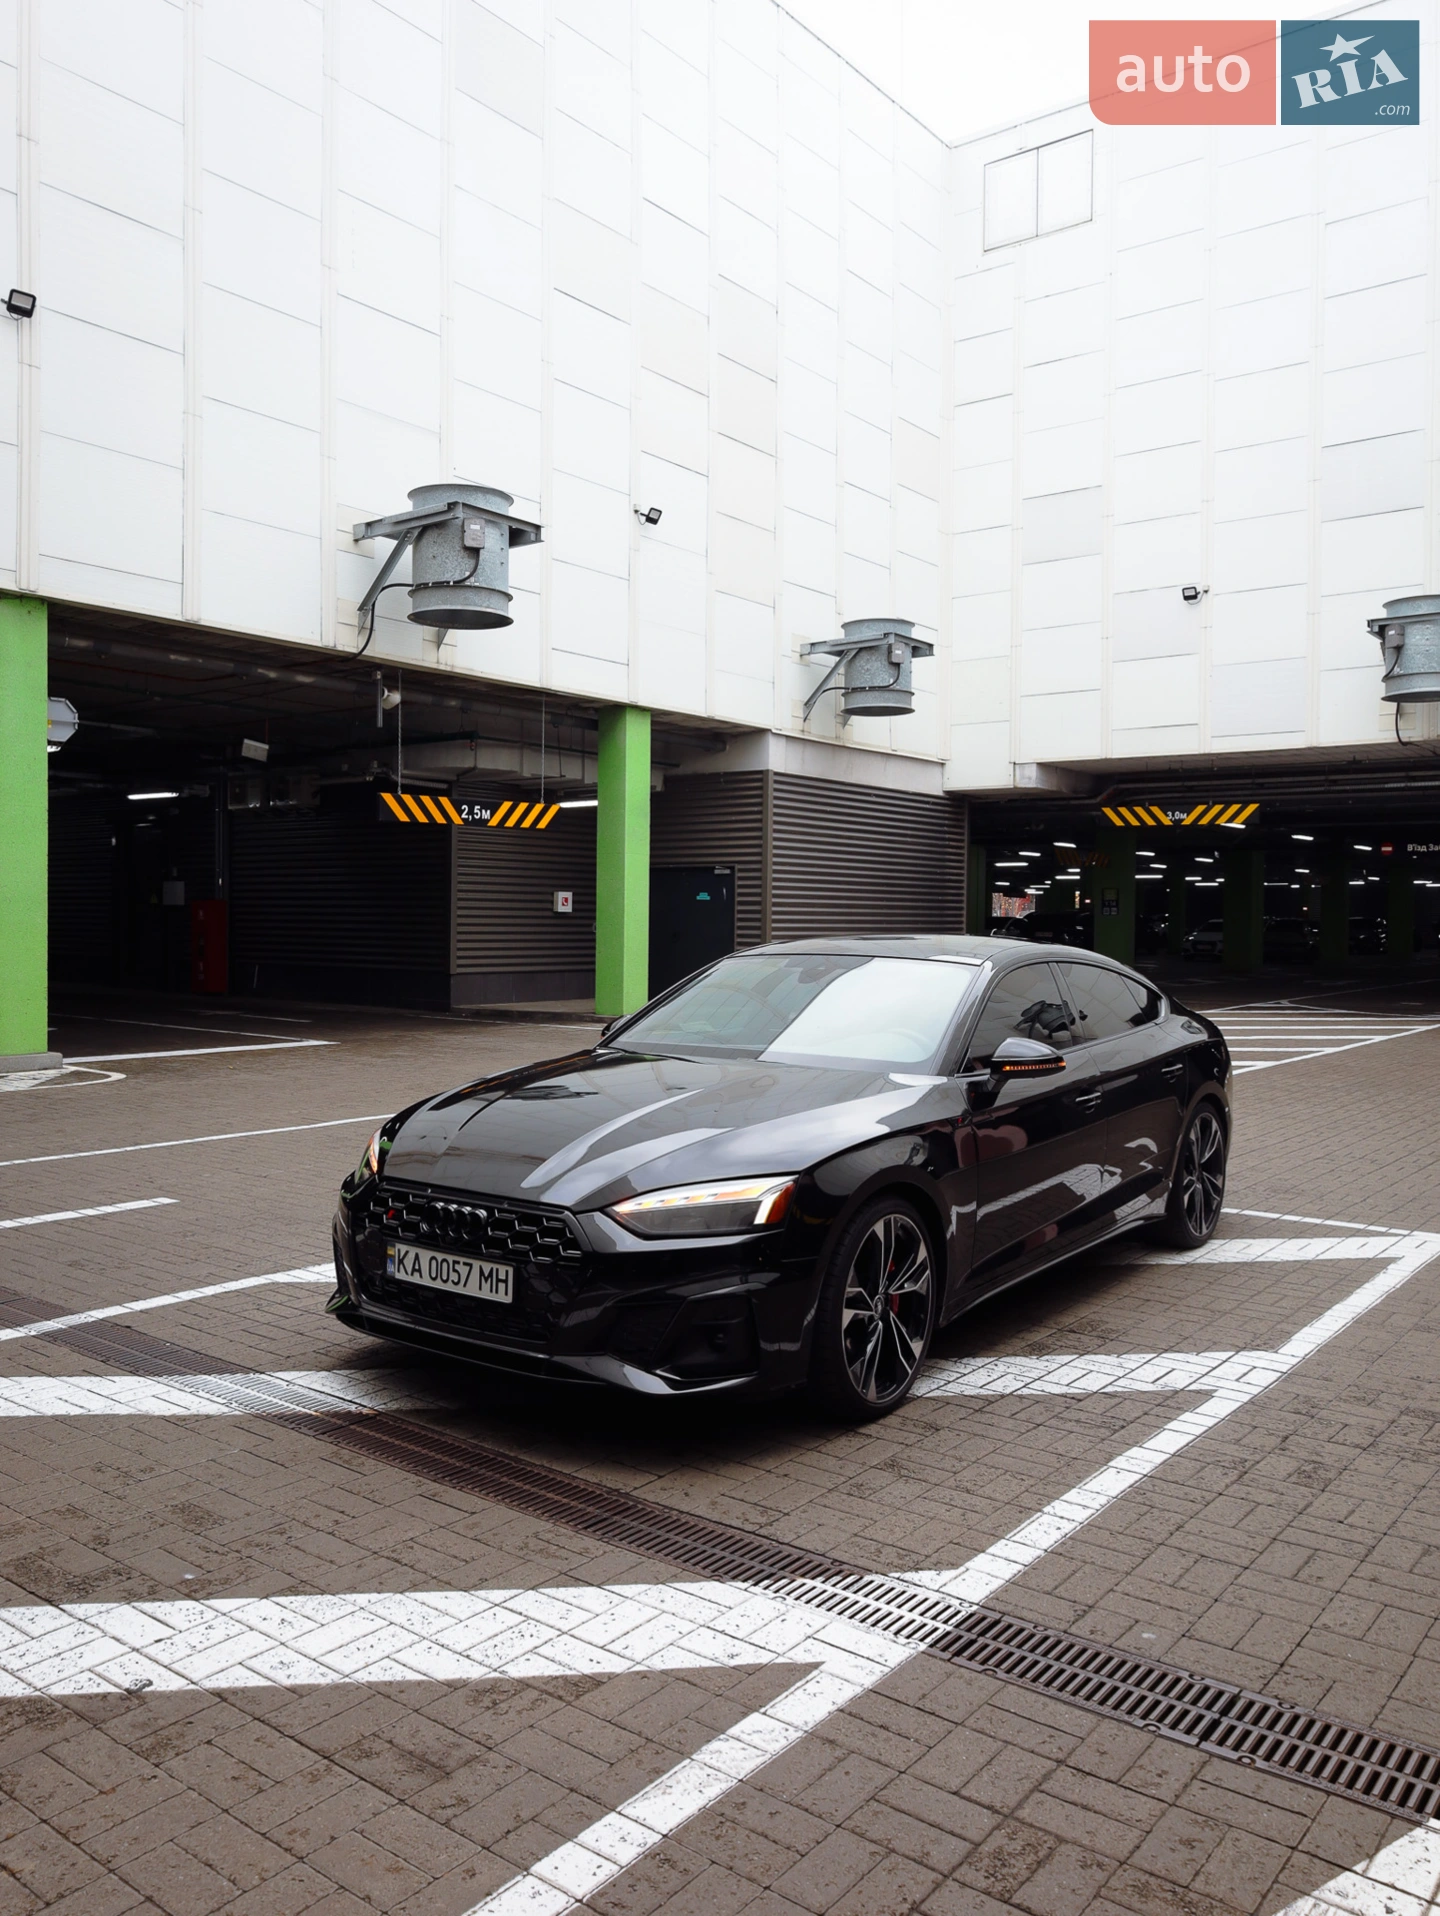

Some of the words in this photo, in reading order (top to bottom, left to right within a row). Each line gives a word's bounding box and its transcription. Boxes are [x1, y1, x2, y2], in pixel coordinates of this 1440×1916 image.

[397, 1248, 423, 1279] KA
[428, 1255, 473, 1288] 0057
[478, 1264, 509, 1296] MH
